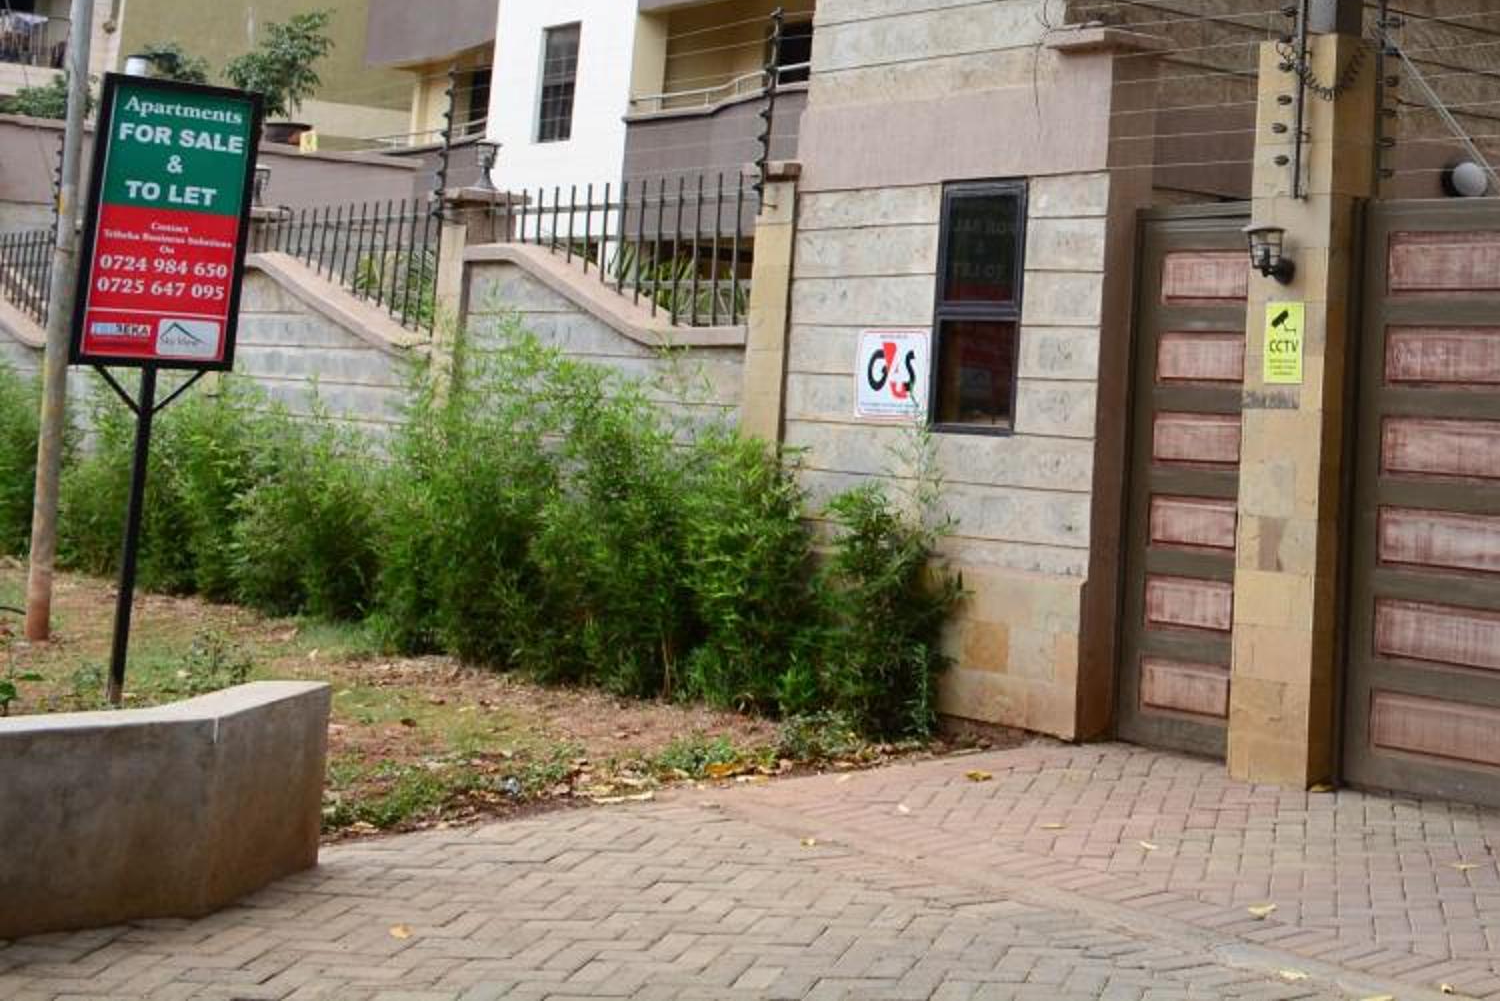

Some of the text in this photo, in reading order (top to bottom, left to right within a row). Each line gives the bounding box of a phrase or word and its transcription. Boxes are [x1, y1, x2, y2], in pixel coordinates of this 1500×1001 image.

[124, 95, 242, 124] Apartments
[119, 122, 243, 154] FOR SALE
[166, 154, 183, 173] &
[125, 180, 217, 206] TO LET
[100, 255, 228, 278] 0724 984 650
[97, 277, 225, 300] 0725 647 095
[1269, 340, 1298, 352] CCTV
[867, 341, 917, 399] G4S
